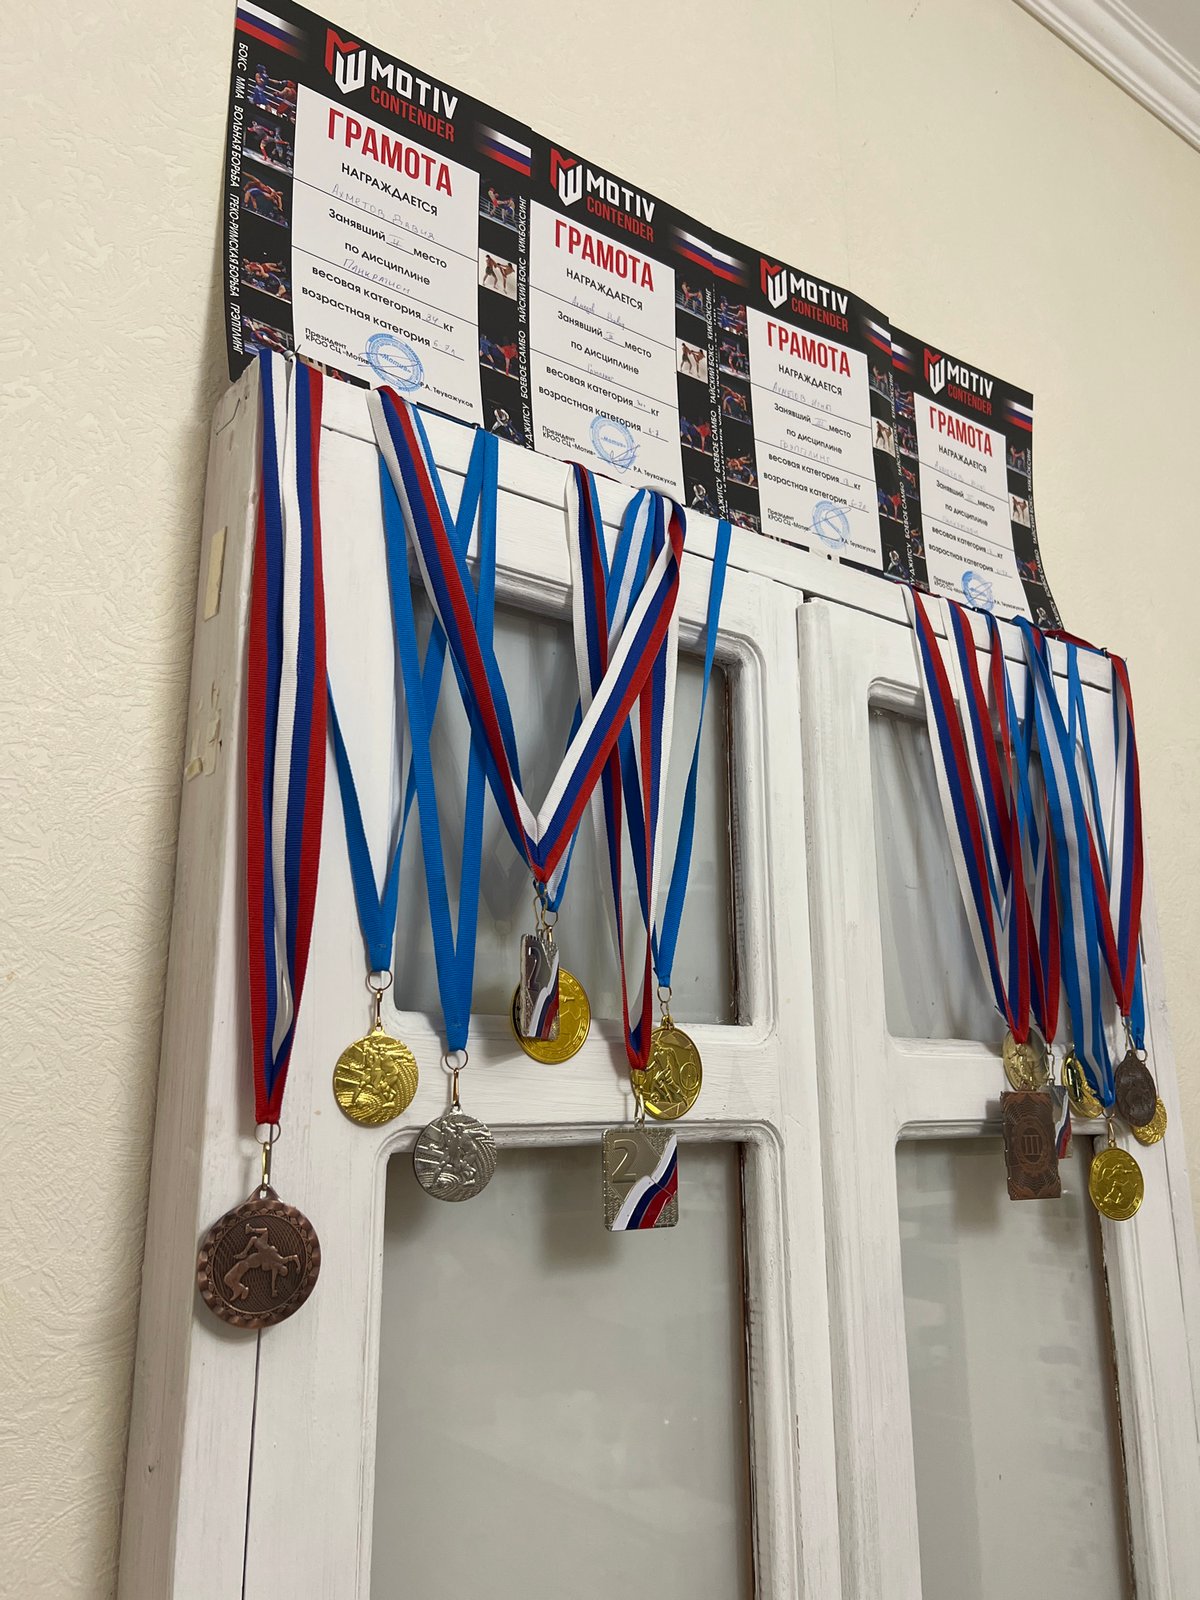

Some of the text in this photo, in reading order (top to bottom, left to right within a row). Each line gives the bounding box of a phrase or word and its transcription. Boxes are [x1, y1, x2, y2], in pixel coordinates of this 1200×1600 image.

[370, 54, 459, 120] MOTIV
[370, 85, 456, 142] CONTENDER
[327, 107, 453, 197] ГРАМОТА
[229, 42, 249, 355] БОКС ММА ВОЛЬНАЯ БОРЬБА ГРЕКО-РИМСКАЯ БОРЬБА ГРЭППЛИНГ
[341, 162, 438, 216] НАГРАЖДАЕТСЯ
[586, 168, 655, 223] MOTIV
[518, 196, 527, 254] КИКБОКСИНГ
[586, 195, 654, 243] CONTENDER
[328, 208, 386, 242] Занявший
[413, 246, 448, 269] место
[555, 218, 655, 292] ГРАМОТА
[345, 242, 431, 286] по дисциплине
[518, 257, 527, 283] БОКС
[312, 266, 361, 293] весовая
[363, 288, 421, 319] категория
[443, 322, 455, 333] кг
[518, 283, 527, 324] ТАЙСКИЙ
[566, 268, 643, 311] НАГРАЖДАЕТСЯ
[789, 272, 849, 315] MOTIV
[301, 286, 371, 324] возрастная
[373, 316, 431, 347] категория
[705, 288, 713, 340] КИКБОКСИНГ
[790, 297, 849, 333] CONTENDER
[305, 328, 347, 350] Президент
[305, 334, 328, 349] КРОО
[329, 343, 343, 355] СЦ
[518, 330, 527, 364] САМБО
[557, 310, 603, 337] Занявший
[624, 341, 652, 358] место
[767, 321, 851, 378] ГРАМОТА
[570, 341, 639, 375] по дисциплине
[707, 343, 715, 367] БОКС
[520, 363, 529, 399] БОЕВОЕ
[546, 365, 660, 417] весовая категория кг
[708, 367, 717, 405] ТАЙСКИЙ
[778, 363, 843, 396] НАГРАЖДАЕТСЯ
[947, 361, 994, 399] MOTIV
[538, 386, 593, 413] возрастная
[595, 407, 642, 432] категория
[947, 383, 992, 417] CONTENDER
[542, 425, 575, 443] Президент
[542, 431, 561, 444] КРОО
[710, 410, 719, 441] САМБО
[774, 402, 812, 424] Занявший
[828, 424, 852, 439] место
[929, 405, 993, 458] ГРАМОТА
[712, 442, 721, 473] БОЕВОЕ
[786, 428, 843, 455] по дисциплине
[938, 444, 987, 473] НАГРАЖДАЕТСЯ
[763, 472, 808, 493] возрастная
[809, 485, 848, 506] категория
[768, 453, 800, 471] весовая
[801, 463, 840, 484] категория
[853, 483, 861, 491] кг
[936, 479, 965, 499] Занявший
[899, 481, 907, 509] САМБО
[945, 503, 953, 512] по
[902, 510, 910, 539] БОЕВОЕ
[957, 536, 987, 553] категория
[963, 556, 994, 573] категория
[611, 1139, 639, 1184] 2
